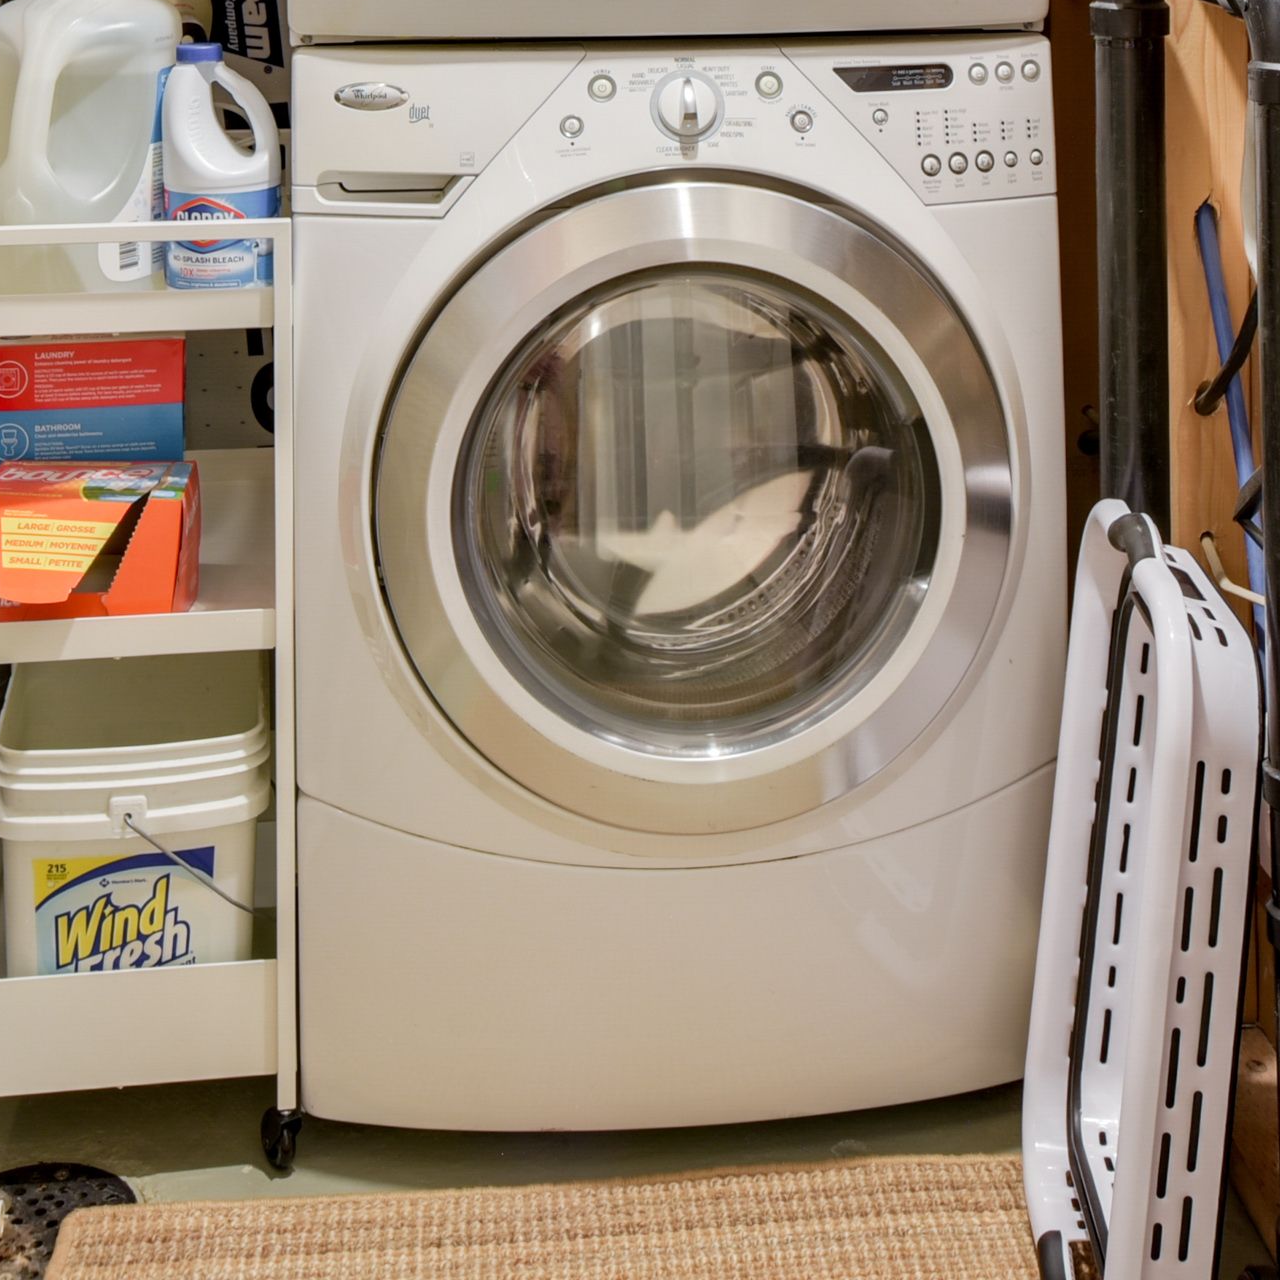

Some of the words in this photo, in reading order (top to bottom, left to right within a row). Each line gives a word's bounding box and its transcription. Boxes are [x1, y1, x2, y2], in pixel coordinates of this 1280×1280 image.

[352, 89, 387, 100] Whirlpool
[409, 102, 431, 123] duet
[212, 255, 244, 264] BLEACH
[34, 351, 75, 360] LAUNDRY
[34, 423, 81, 432] BATHROOM
[17, 522, 50, 531] LARGE
[56, 524, 96, 534] GROSSE
[5, 539, 43, 548] MEDIUM
[50, 540, 98, 551] MOYENNE
[9, 556, 42, 566] SMALL
[48, 559, 83, 568] PETITE
[47, 863, 67, 873] 215
[55, 873, 170, 970] Wind
